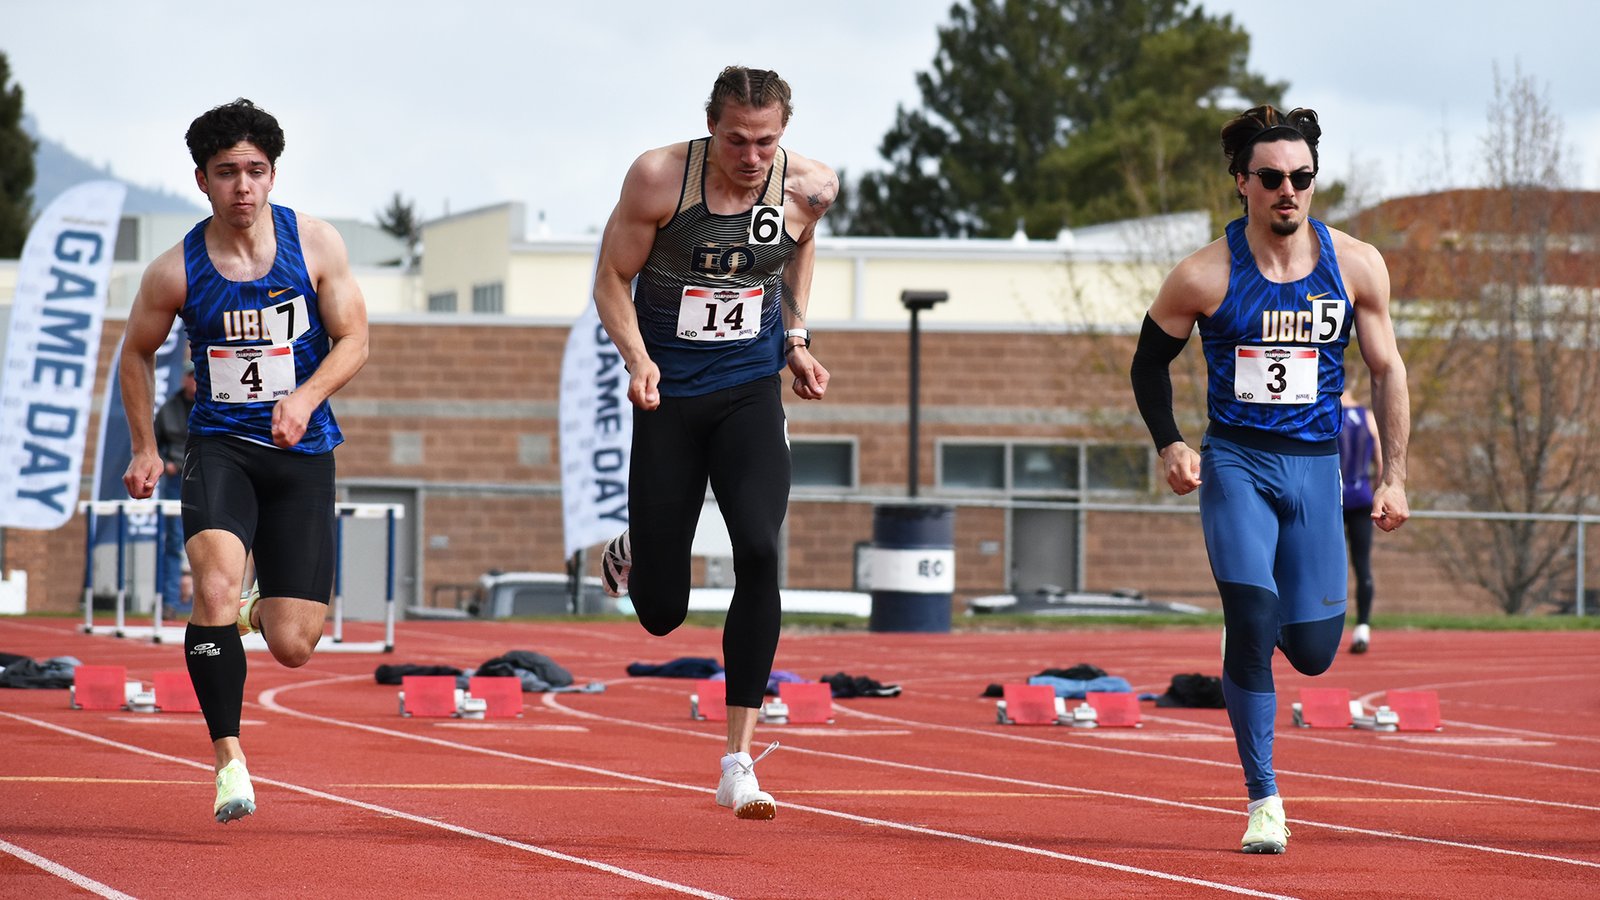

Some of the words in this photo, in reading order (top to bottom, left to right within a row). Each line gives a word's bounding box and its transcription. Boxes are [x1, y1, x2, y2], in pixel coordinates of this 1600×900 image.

[752, 207, 780, 244] 6
[33, 229, 104, 389] GAME
[276, 302, 295, 341] 7
[702, 302, 745, 332] 14
[1261, 310, 1312, 343] UBC
[1318, 302, 1339, 342] 5
[240, 361, 263, 393] 4
[1266, 363, 1288, 394] 3
[17, 402, 79, 515] DAY
[591, 448, 629, 524] DAY
